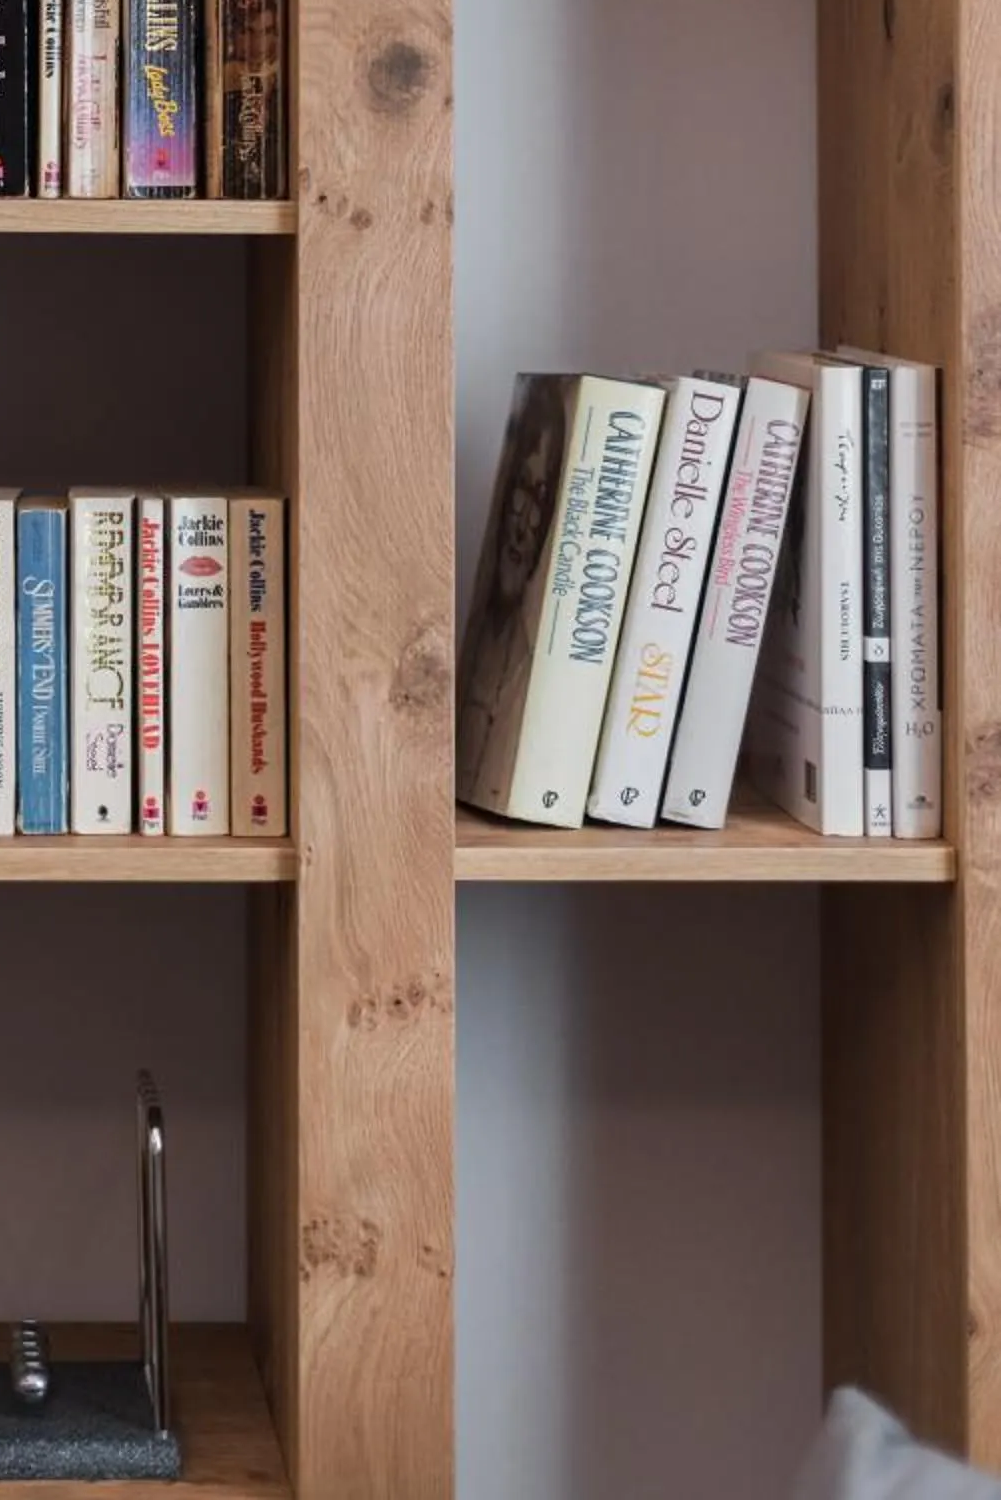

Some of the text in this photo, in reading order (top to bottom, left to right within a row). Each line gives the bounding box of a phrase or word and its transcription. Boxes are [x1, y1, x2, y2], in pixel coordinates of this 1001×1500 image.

[45, 27, 62, 79] Collins
[143, 65, 179, 137] Lady Boss
[178, 514, 224, 530] Jackie
[178, 531, 224, 546] Collins
[551, 465, 596, 597] The Black Candle
[567, 410, 646, 665] CATHERINE COOKSON
[626, 389, 725, 738] Danielle Steel STAR
[714, 467, 755, 587] The Wingless Bird
[724, 418, 800, 647] CATHERINE COOKSON
[909, 494, 926, 571] ΝΕΡΟΥ
[85, 511, 125, 711] REMEMBRANCE
[140, 517, 159, 750] Jackie Collins LOVEHEAD
[212, 584, 224, 597] &
[839, 580, 851, 662] TSAROUCHIS
[31, 654, 55, 700] END
[246, 508, 268, 775] Jackie Collins Hollywood Husbands
[910, 604, 927, 711] ΧΡΩΜΑΤΑ
[105, 723, 125, 778] Danielle
